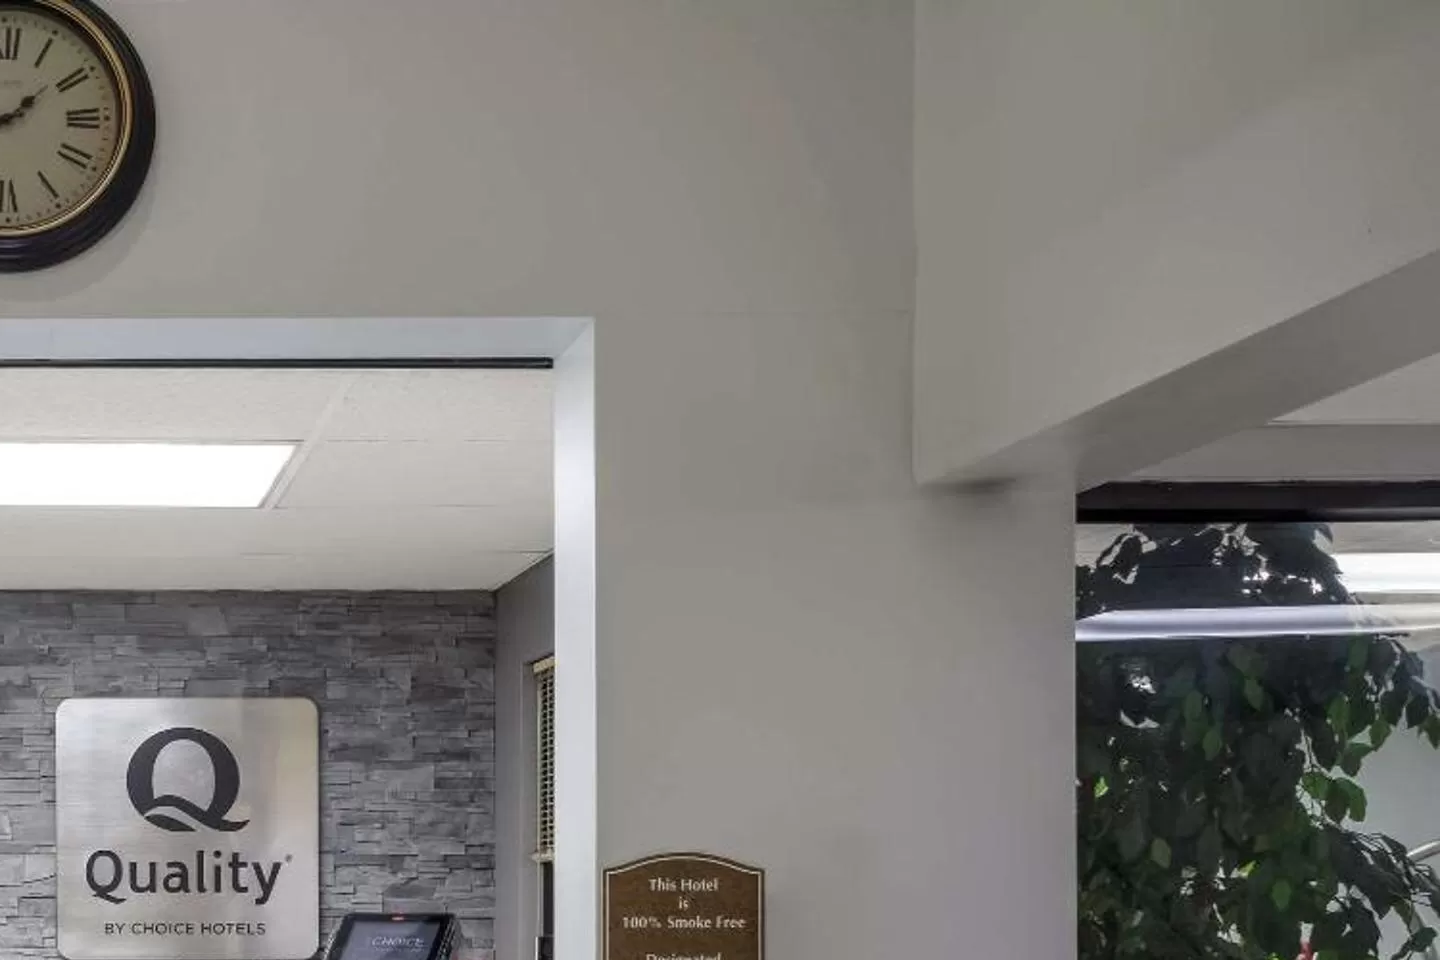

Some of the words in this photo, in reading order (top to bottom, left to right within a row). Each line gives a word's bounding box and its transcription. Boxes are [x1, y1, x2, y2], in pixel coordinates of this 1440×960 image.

[125, 726, 250, 833] Q
[85, 849, 284, 905] Quality
[648, 878, 677, 892] This
[680, 878, 719, 892] Hotel
[677, 896, 689, 910] is
[104, 922, 124, 935] BY
[131, 922, 195, 936] CHOICE
[200, 922, 266, 936] HOTELS
[622, 916, 663, 929] 100%
[667, 915, 711, 929] Smoke
[715, 915, 747, 929] Free
